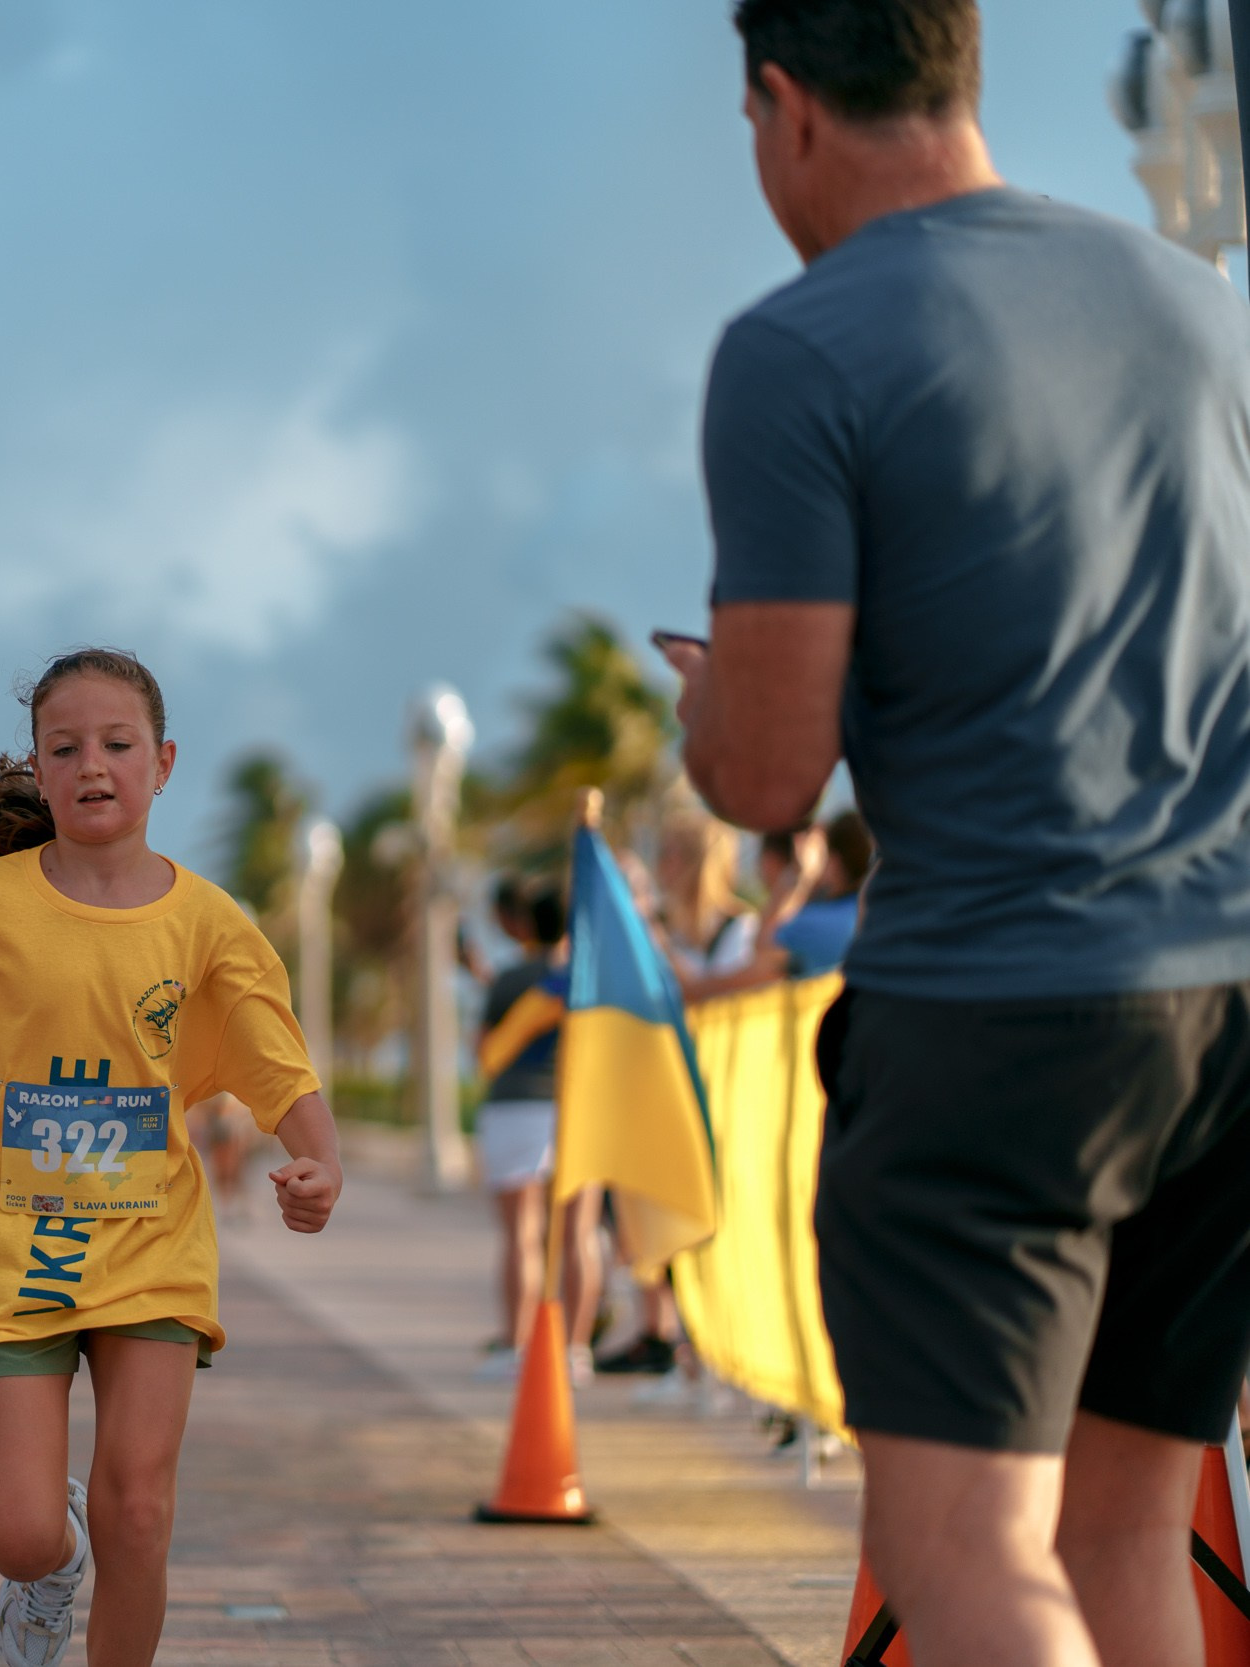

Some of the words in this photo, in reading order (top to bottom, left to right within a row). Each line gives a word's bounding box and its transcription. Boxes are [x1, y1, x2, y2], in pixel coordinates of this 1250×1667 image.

[136, 983, 161, 1008] RAZOM
[19, 1091, 79, 1108] RAZOM
[117, 1095, 151, 1107] RUN
[31, 1118, 128, 1173] 322
[73, 1201, 107, 1210] SLAVA
[110, 1200, 159, 1209] UKRAINI!
